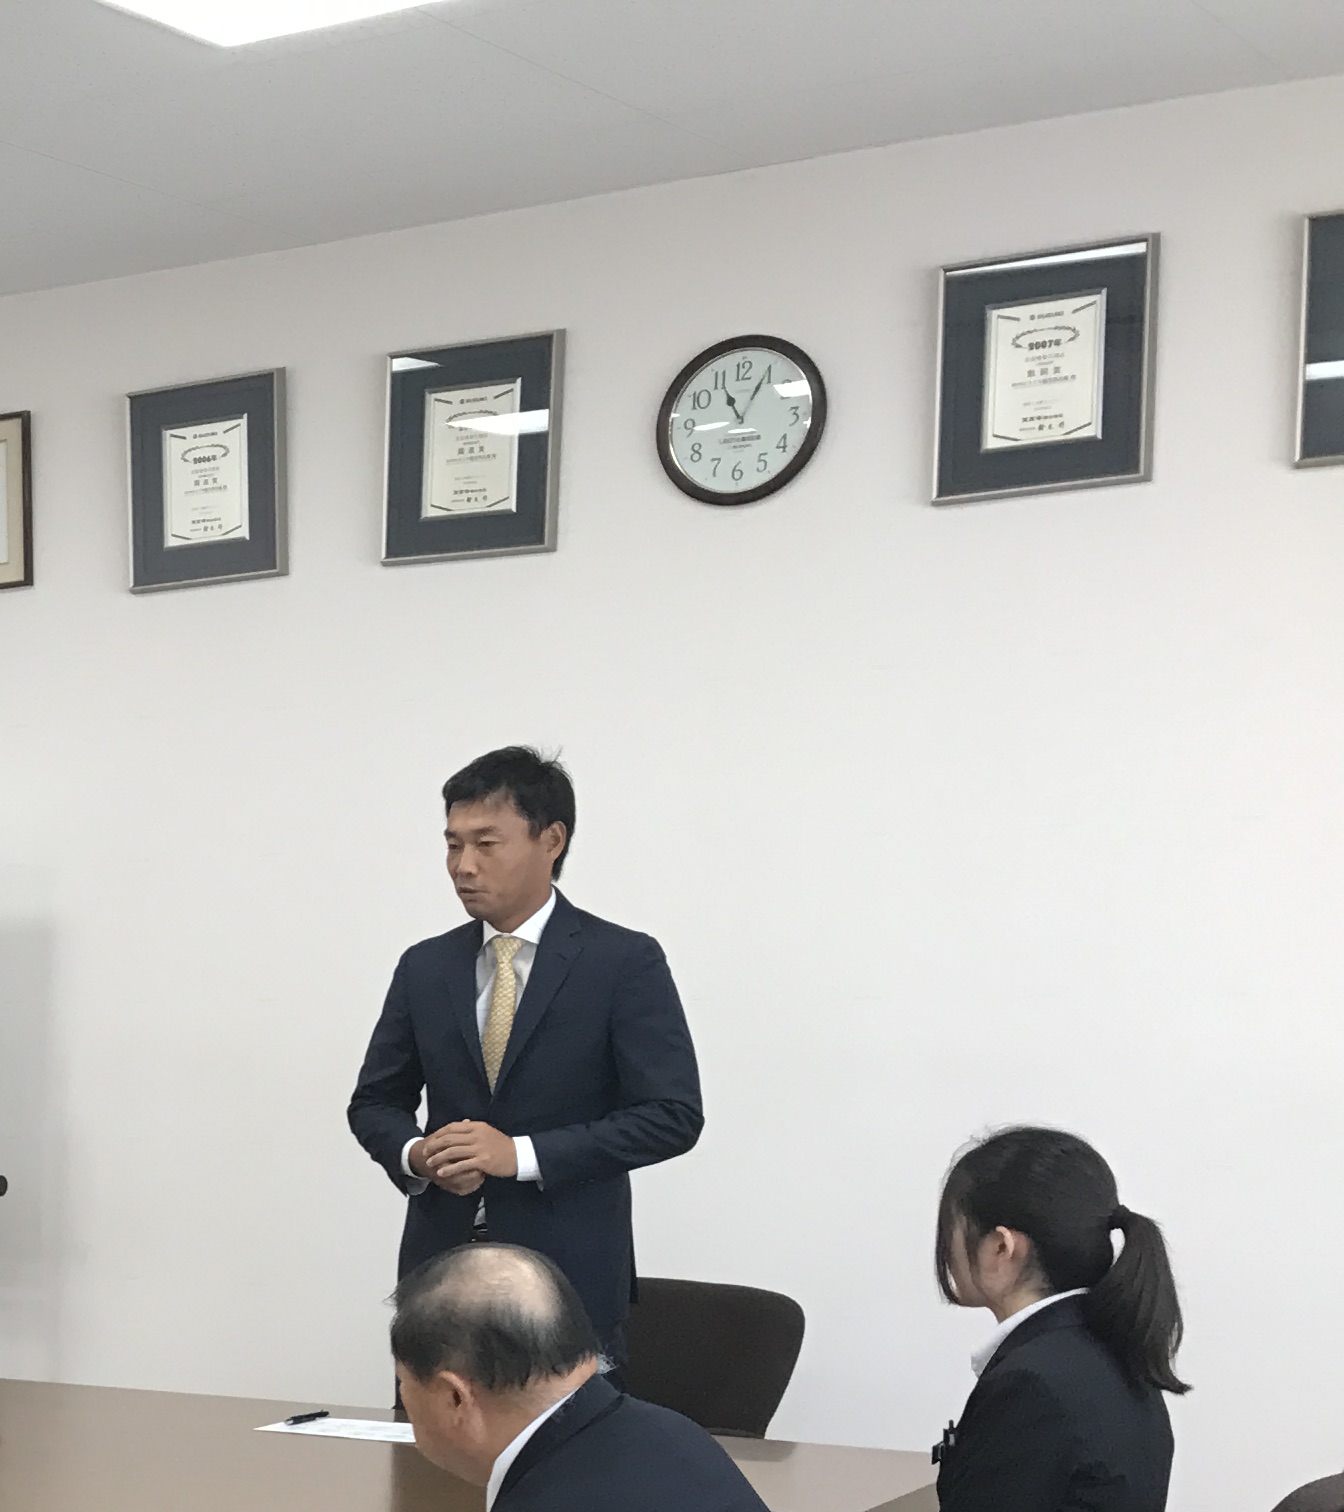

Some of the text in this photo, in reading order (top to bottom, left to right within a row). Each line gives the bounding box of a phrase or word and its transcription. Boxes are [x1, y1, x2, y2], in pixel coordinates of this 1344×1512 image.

[713, 370, 726, 390] 11
[735, 360, 753, 382] 12
[764, 364, 772, 384] 1
[691, 389, 712, 410] 10
[788, 406, 800, 427] 3
[683, 418, 696, 438] 9
[690, 442, 702, 463] 8
[775, 432, 788, 453] 4
[710, 457, 722, 478] 7
[731, 460, 744, 481] 6
[756, 452, 768, 473] 5
